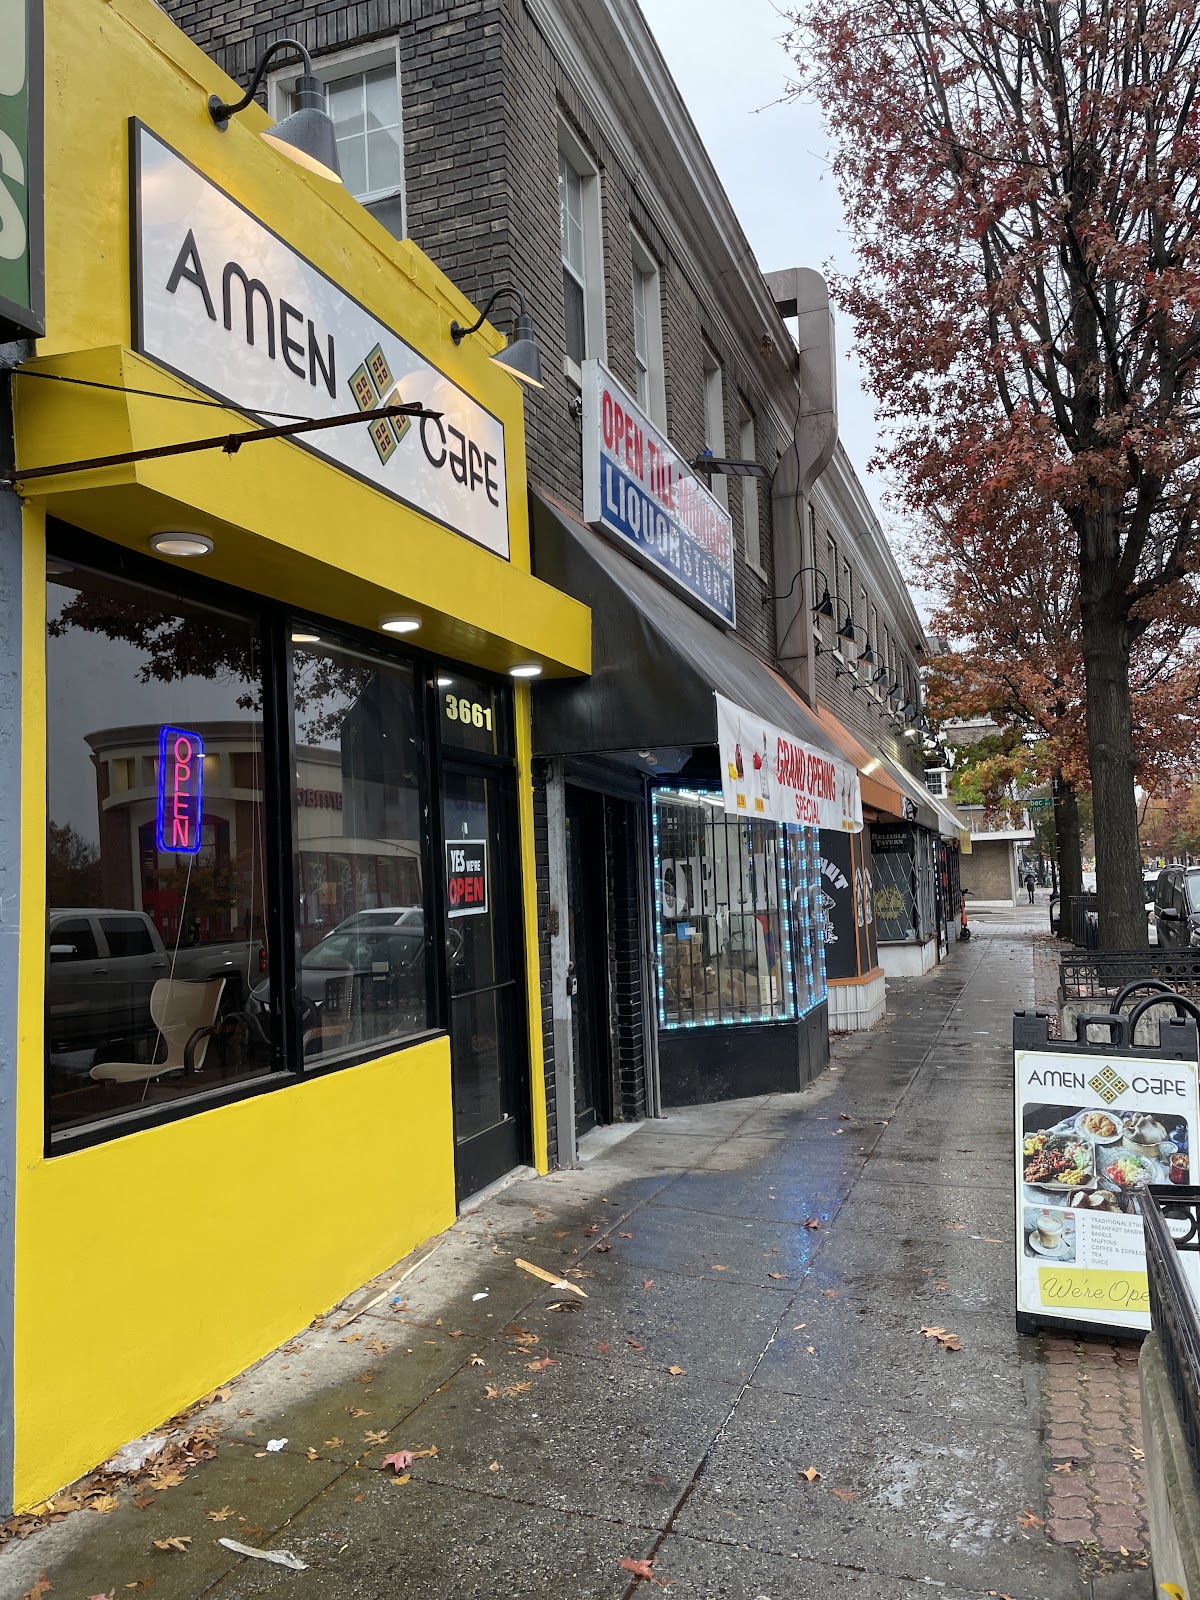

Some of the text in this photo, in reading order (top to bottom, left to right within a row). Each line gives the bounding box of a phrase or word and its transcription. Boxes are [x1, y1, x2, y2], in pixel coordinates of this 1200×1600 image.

[166, 228, 337, 399] AMEN
[602, 389, 644, 482] OPEN
[648, 438, 676, 511] TILL
[605, 462, 732, 612] LIQUOR STORE
[445, 694, 492, 731] 3661
[775, 737, 836, 802] GRAND OPENING
[173, 737, 192, 847] OPEN
[795, 794, 821, 825] SPECIAL
[871, 833, 908, 841] RELIABLE
[876, 839, 904, 847] TAVERN
[450, 849, 465, 873] YES
[449, 876, 484, 905] OPEN
[1027, 1070, 1085, 1089] AMEN
[1091, 1217, 1127, 1226] TRADITIONAL
[1091, 1224, 1122, 1232] BREAKFAST
[1091, 1238, 1117, 1246] MUFFINS
[1091, 1244, 1113, 1252] COFFEE
[1121, 1248, 1146, 1256] ESPRESS
[1091, 1258, 1109, 1266] JUICE
[1042, 1277, 1150, 1307] We're Ope
